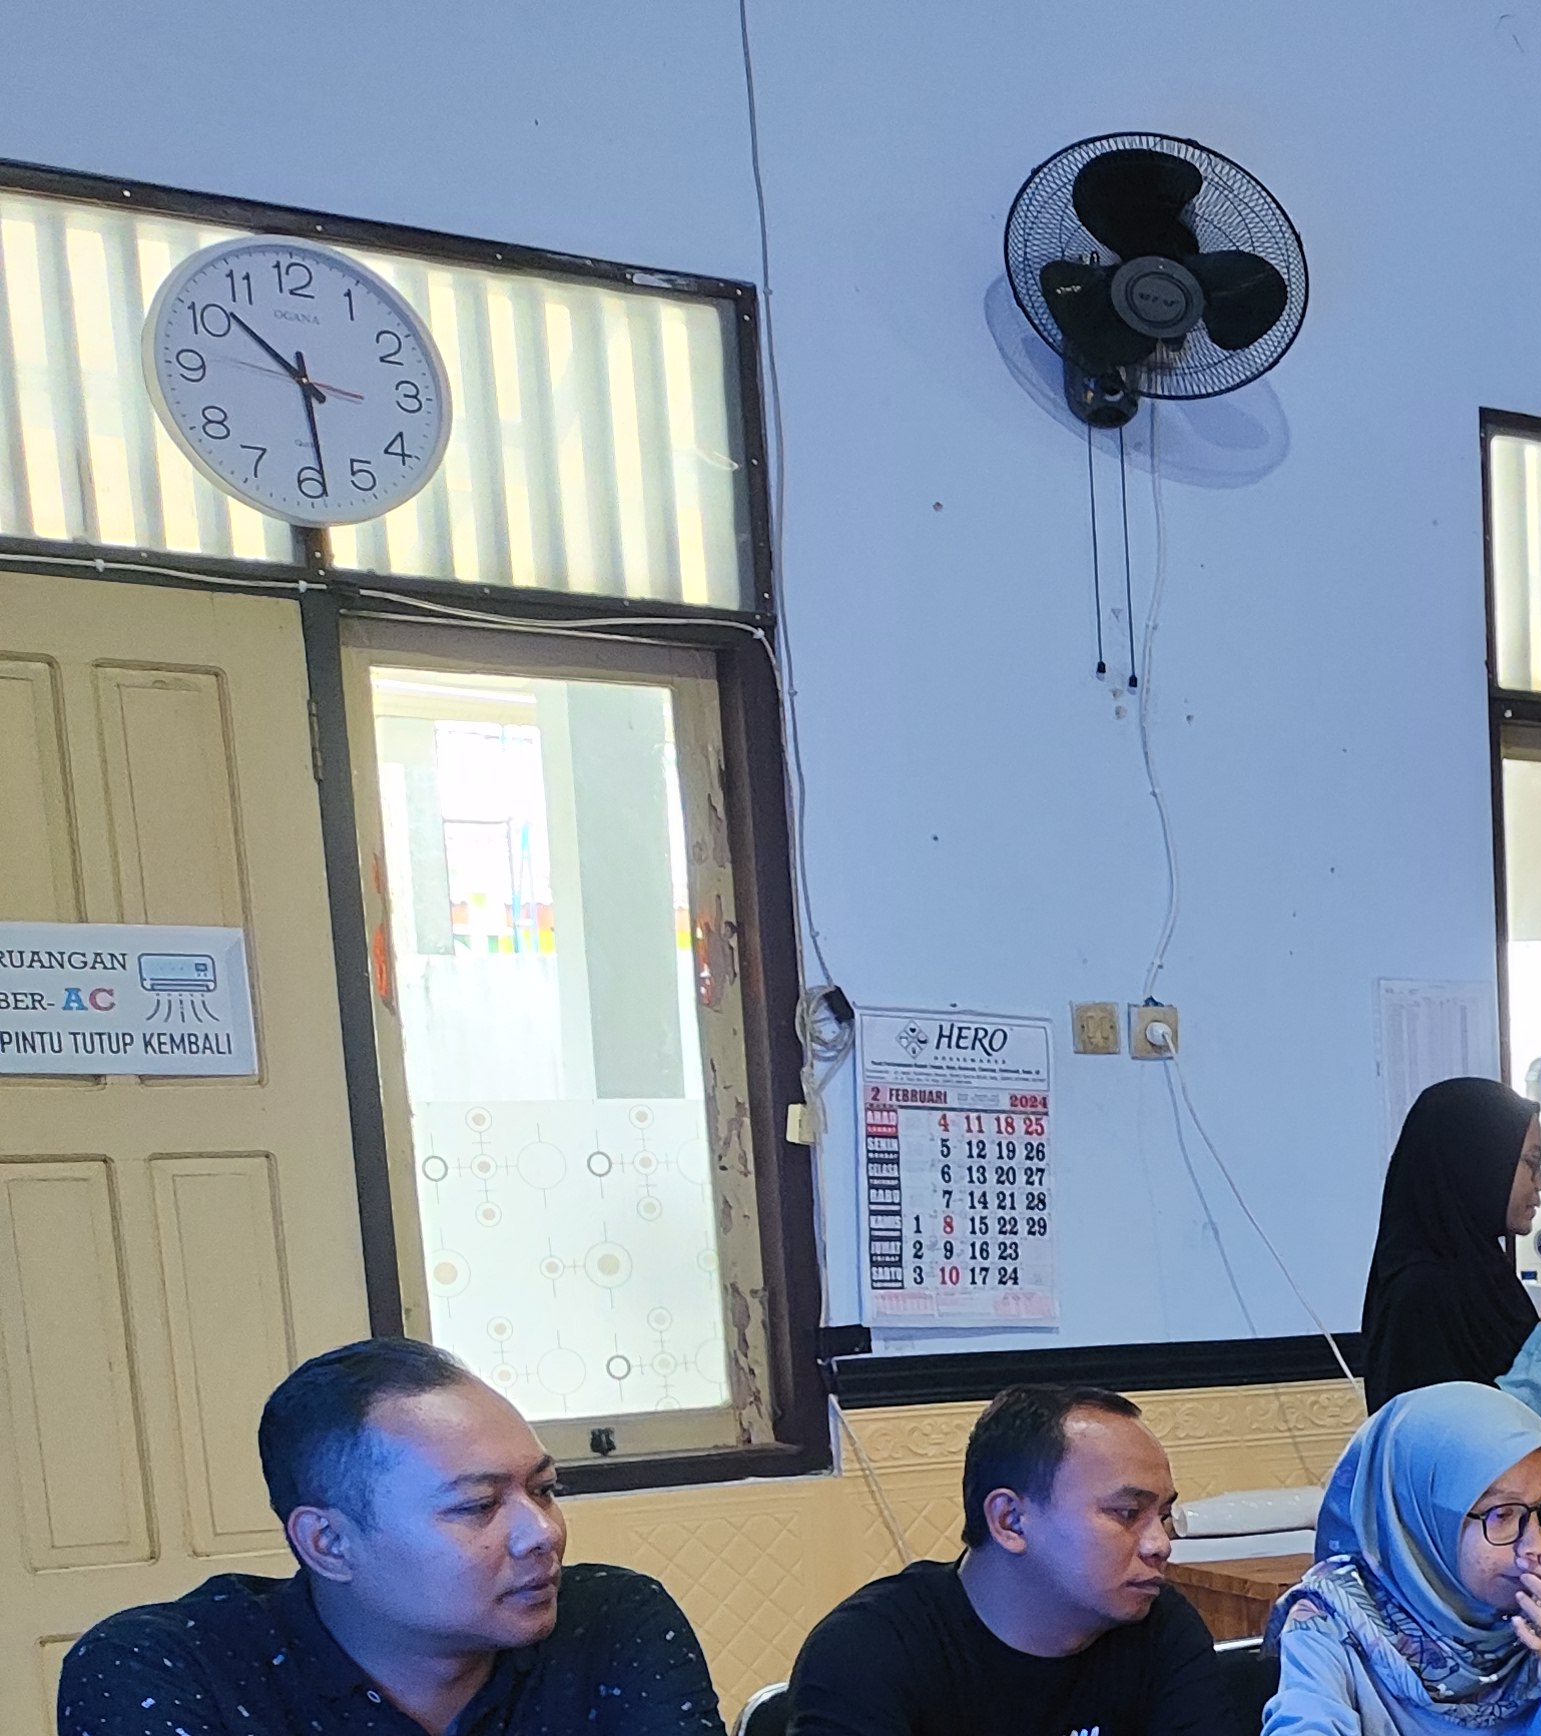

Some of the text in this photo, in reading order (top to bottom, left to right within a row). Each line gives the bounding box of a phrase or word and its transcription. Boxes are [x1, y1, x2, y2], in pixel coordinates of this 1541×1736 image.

[225, 269, 253, 306] 11
[272, 260, 315, 299] 12
[187, 301, 231, 338] 10
[343, 288, 355, 322] 1
[375, 329, 405, 366] 2
[174, 348, 207, 383] 9
[395, 380, 424, 414] 3
[201, 405, 231, 440] 8
[240, 443, 268, 479] 7
[383, 431, 413, 467] 4
[296, 466, 328, 500] 6
[349, 457, 377, 492] 5
[69, 1032, 134, 1055] TUTUP
[142, 1032, 233, 1055] KEMBALI
[935, 1022, 1009, 1057] HERO
[871, 1086, 881, 1101] 2
[888, 1088, 948, 1105] FEBRUARI
[1009, 1095, 1049, 1109] 2024
[938, 1113, 950, 1133] 4
[965, 1114, 985, 1134] 11
[994, 1115, 1016, 1136] 18
[1022, 1117, 1046, 1136] 25
[940, 1138, 951, 1159] 5
[966, 1139, 987, 1160] 12
[996, 1140, 1017, 1161] 19
[1024, 1142, 1046, 1162] 26
[940, 1164, 952, 1184] 6
[966, 1165, 988, 1185] 13
[994, 1166, 1017, 1186] 20
[1024, 1167, 1046, 1187] 27
[942, 1190, 953, 1209] 7
[968, 1190, 989, 1210] 14
[996, 1191, 1017, 1211] 21
[1025, 1192, 1047, 1212] 28
[913, 1215, 922, 1234] 1
[942, 1215, 954, 1235] 8
[969, 1215, 989, 1236] 15
[997, 1216, 1019, 1236] 22
[1026, 1217, 1048, 1237] 29
[912, 1240, 924, 1260] 2
[943, 1240, 954, 1260] 9
[969, 1241, 990, 1261] 16
[997, 1241, 1020, 1262] 23
[913, 1265, 924, 1286] 3
[939, 1265, 961, 1286] 10
[968, 1266, 990, 1286] 17
[997, 1266, 1020, 1286] 24
